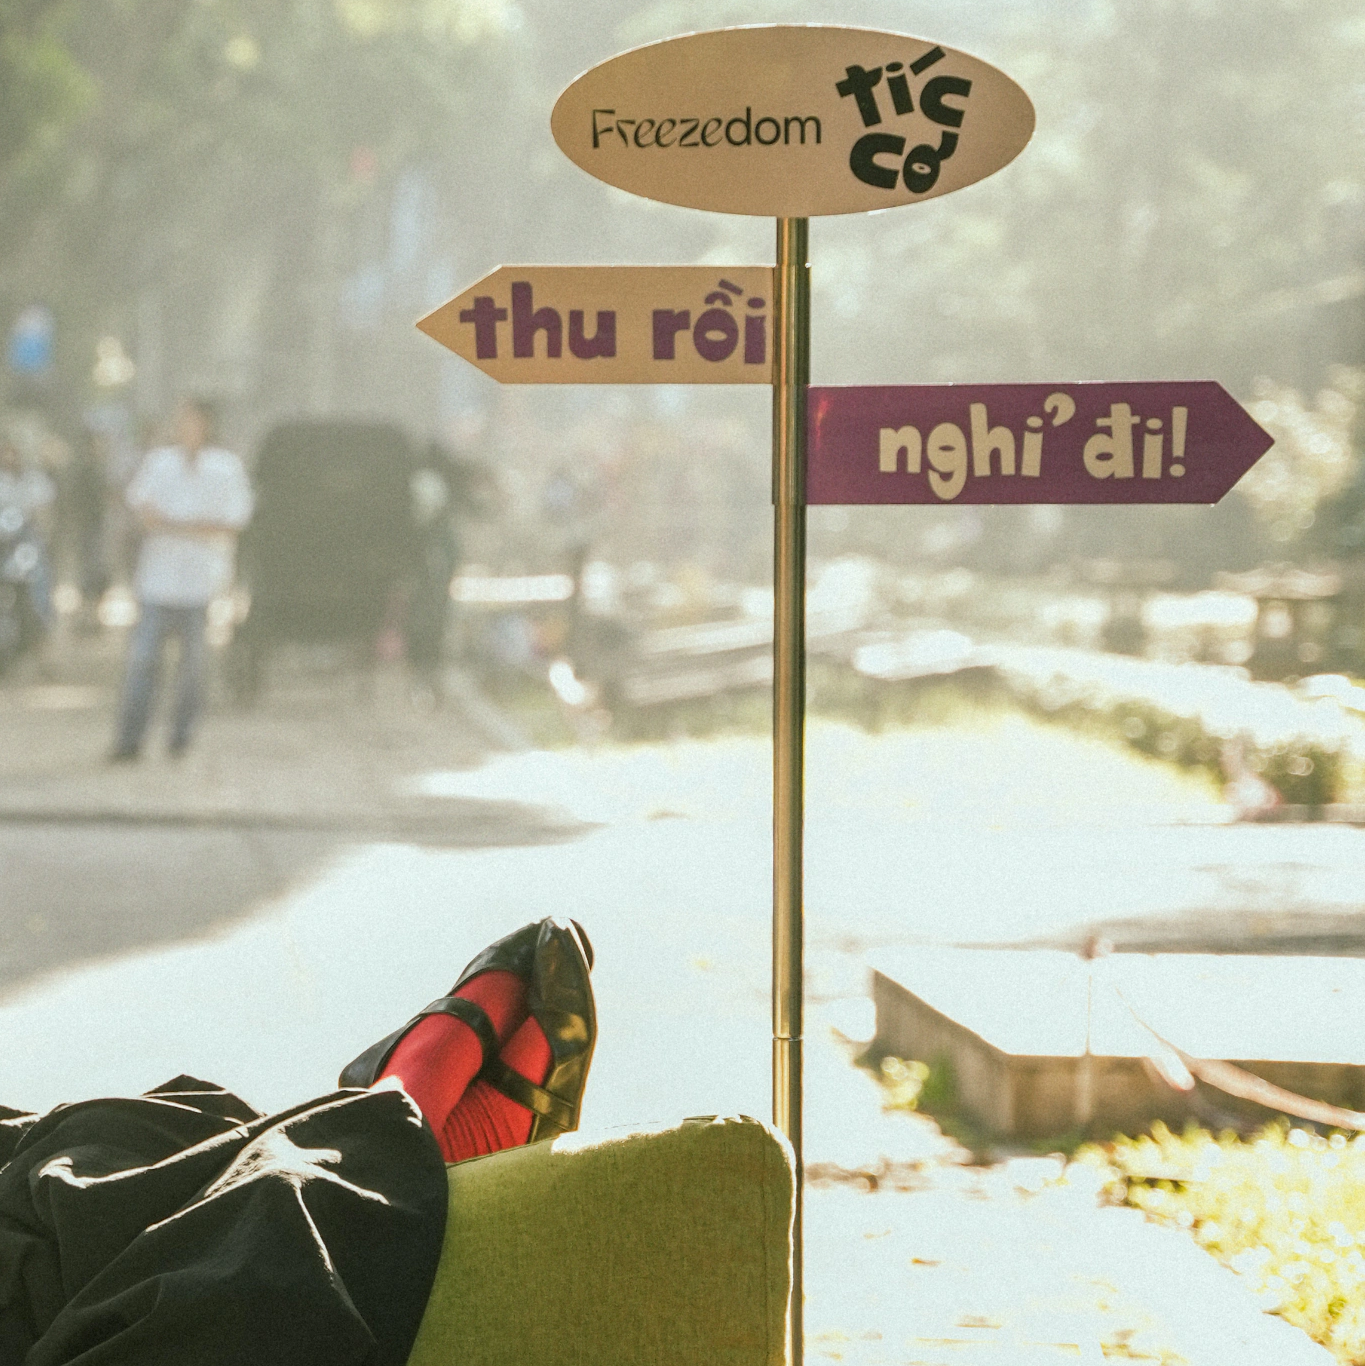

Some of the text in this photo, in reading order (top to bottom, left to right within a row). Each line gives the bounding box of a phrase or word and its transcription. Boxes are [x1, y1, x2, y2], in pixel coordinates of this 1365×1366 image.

[592, 106, 822, 148] Freezedom
[459, 279, 766, 364] thu rồi
[879, 392, 1188, 501] nghỉ đi!
